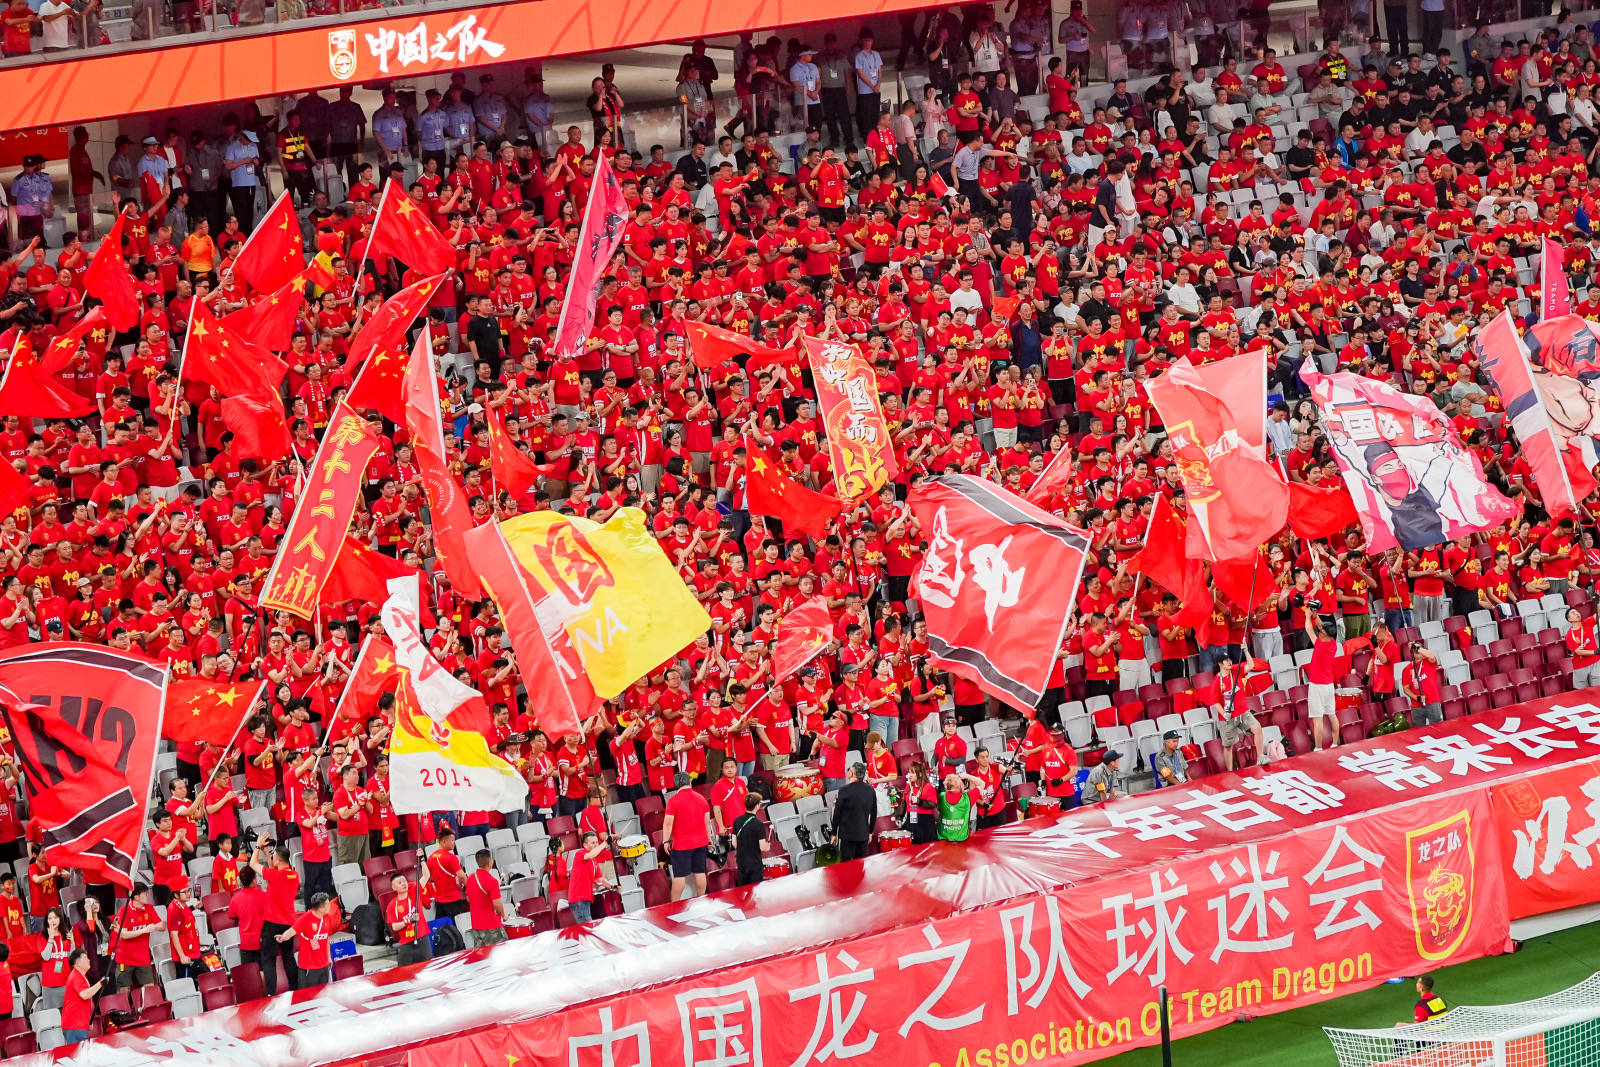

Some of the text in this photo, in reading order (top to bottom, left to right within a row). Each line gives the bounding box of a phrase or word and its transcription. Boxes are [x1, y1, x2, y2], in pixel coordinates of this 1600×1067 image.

[365, 14, 506, 73] 中国之队
[293, 414, 367, 563] 第十二人
[1029, 770, 1346, 859] 千年古都
[1417, 830, 1462, 864] 龙之队
[568, 826, 1386, 1067] 中国龙之队球迷会
[956, 1017, 1133, 1067] Association
[1182, 977, 1262, 1024] Team
[1272, 952, 1374, 994] Dragon
